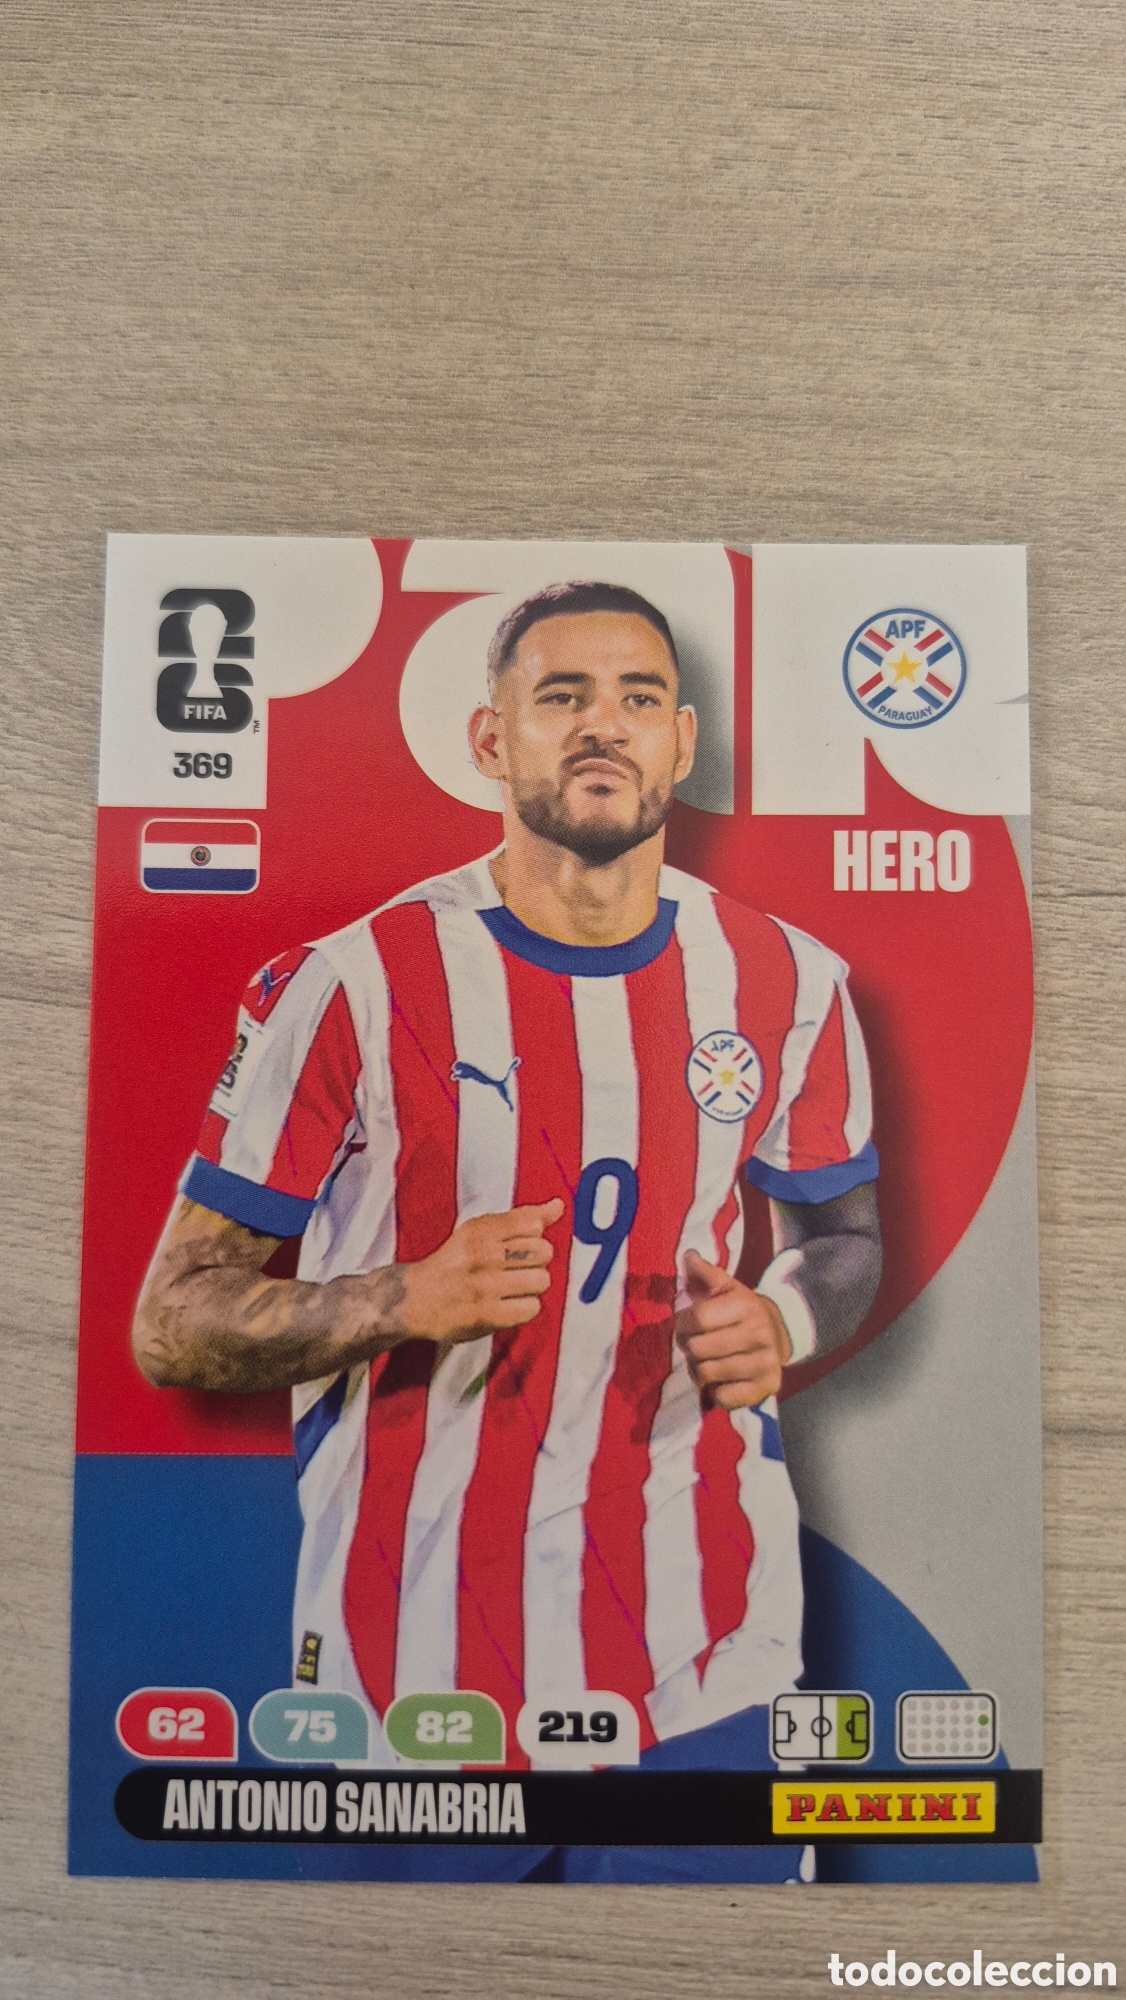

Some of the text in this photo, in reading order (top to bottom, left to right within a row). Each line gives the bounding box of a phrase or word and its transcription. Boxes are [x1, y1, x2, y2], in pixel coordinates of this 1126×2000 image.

[885, 620, 927, 640] APF
[183, 704, 228, 721] FIFA
[253, 719, 260, 735] TM
[877, 705, 933, 721] PARAGUAY
[172, 752, 233, 780] 369
[833, 829, 971, 893] HERO
[573, 1157, 639, 1305] 9
[147, 1706, 206, 1741] 62
[284, 1710, 337, 1744] 75
[415, 1710, 474, 1744] 82
[538, 1709, 618, 1744] 219
[163, 1778, 527, 1834] ANTONIO SANABRIA
[786, 1792, 983, 1823] PANINI
